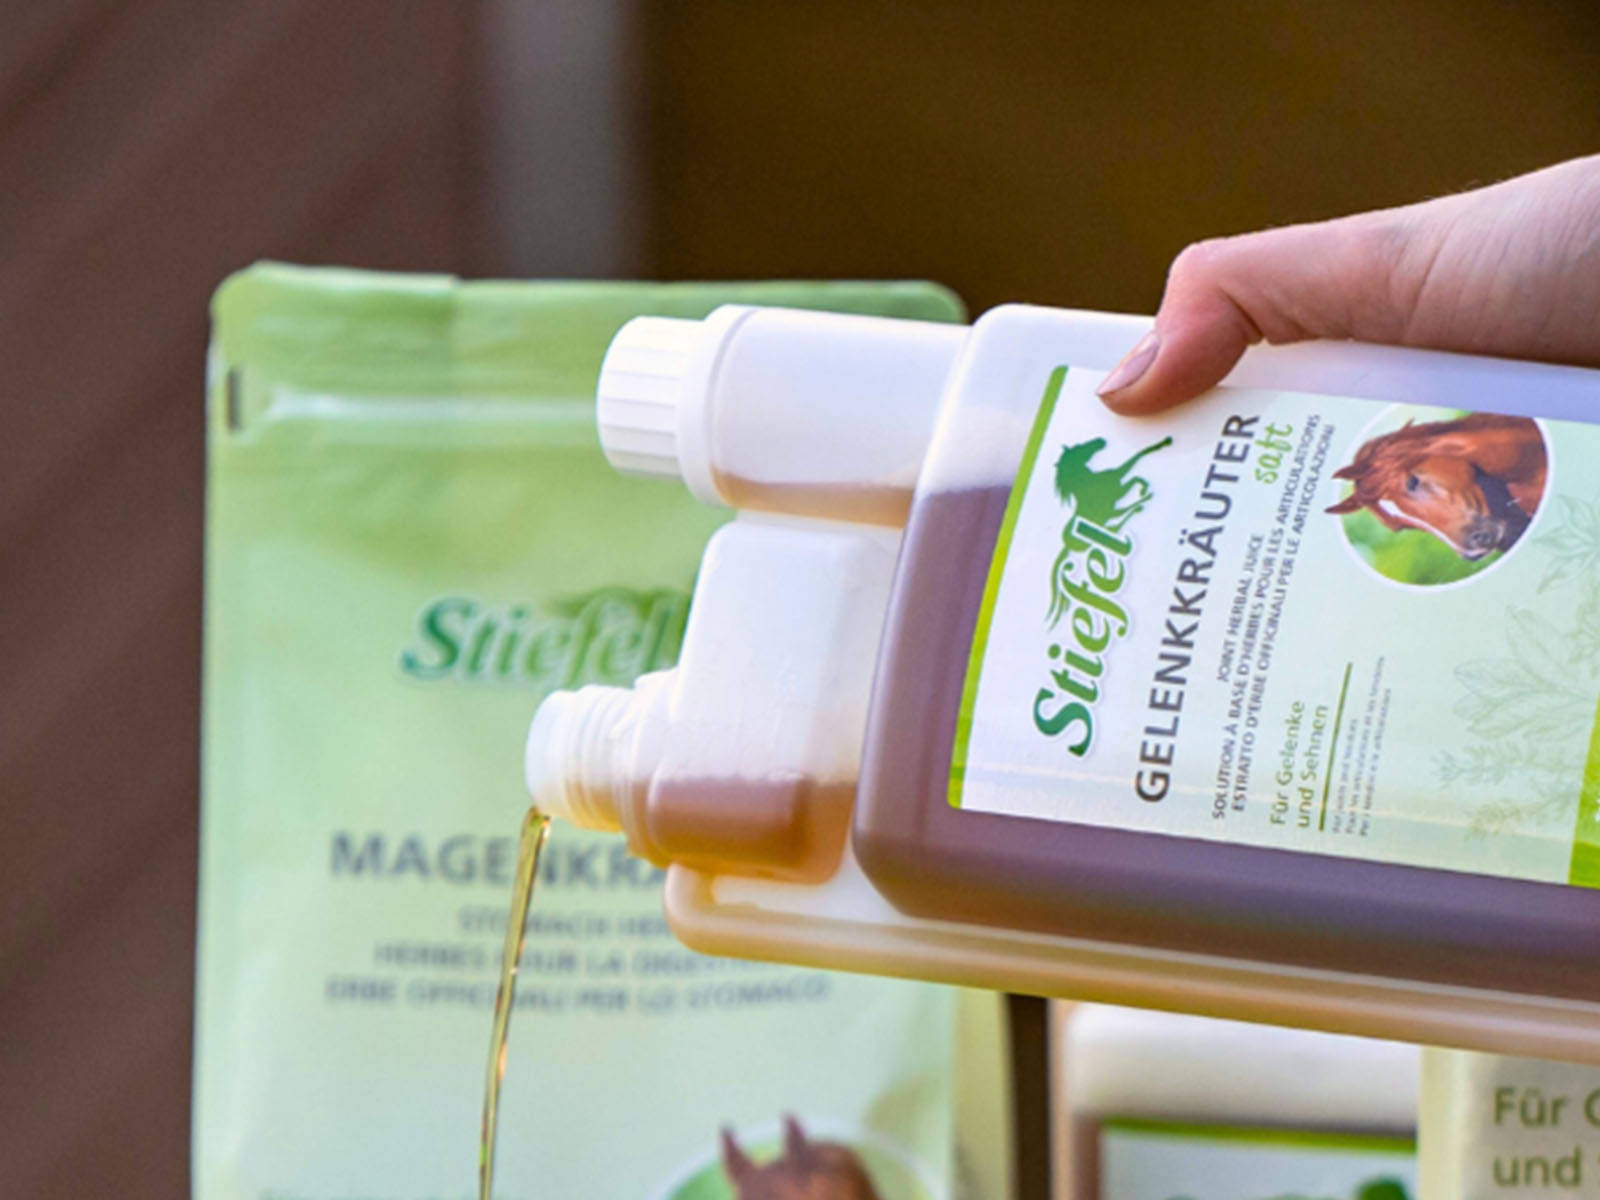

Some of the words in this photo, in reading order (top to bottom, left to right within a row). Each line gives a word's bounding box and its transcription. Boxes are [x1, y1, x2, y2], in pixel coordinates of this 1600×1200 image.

[1255, 423, 1294, 485] saft
[1242, 533, 1264, 573] JUICE
[1277, 557, 1295, 587] PER
[1285, 537, 1300, 556] LE
[1134, 415, 1260, 803] GELENKKRÄUTER
[1212, 738, 1236, 820] SOLUTION
[1228, 679, 1248, 719] BASE
[1254, 557, 1276, 598] POUR
[1266, 527, 1284, 555] LES
[1276, 413, 1321, 525] ARTICULATIONS
[1226, 576, 1252, 636] HERBAL
[1257, 587, 1286, 672] OFFICINALI
[401, 595, 676, 688] Stiefel
[1033, 519, 1132, 757] Stiefel
[1216, 637, 1237, 682] JOINT
[1231, 730, 1256, 813] ESTRATTO
[1274, 700, 1305, 787] Gelenke
[1300, 703, 1330, 782] Sehnen
[1269, 792, 1290, 826] Für
[1296, 786, 1316, 828] und
[330, 831, 665, 887] MAGEKR
[1493, 1086, 1566, 1128] Für
[1493, 1146, 1583, 1188] und
